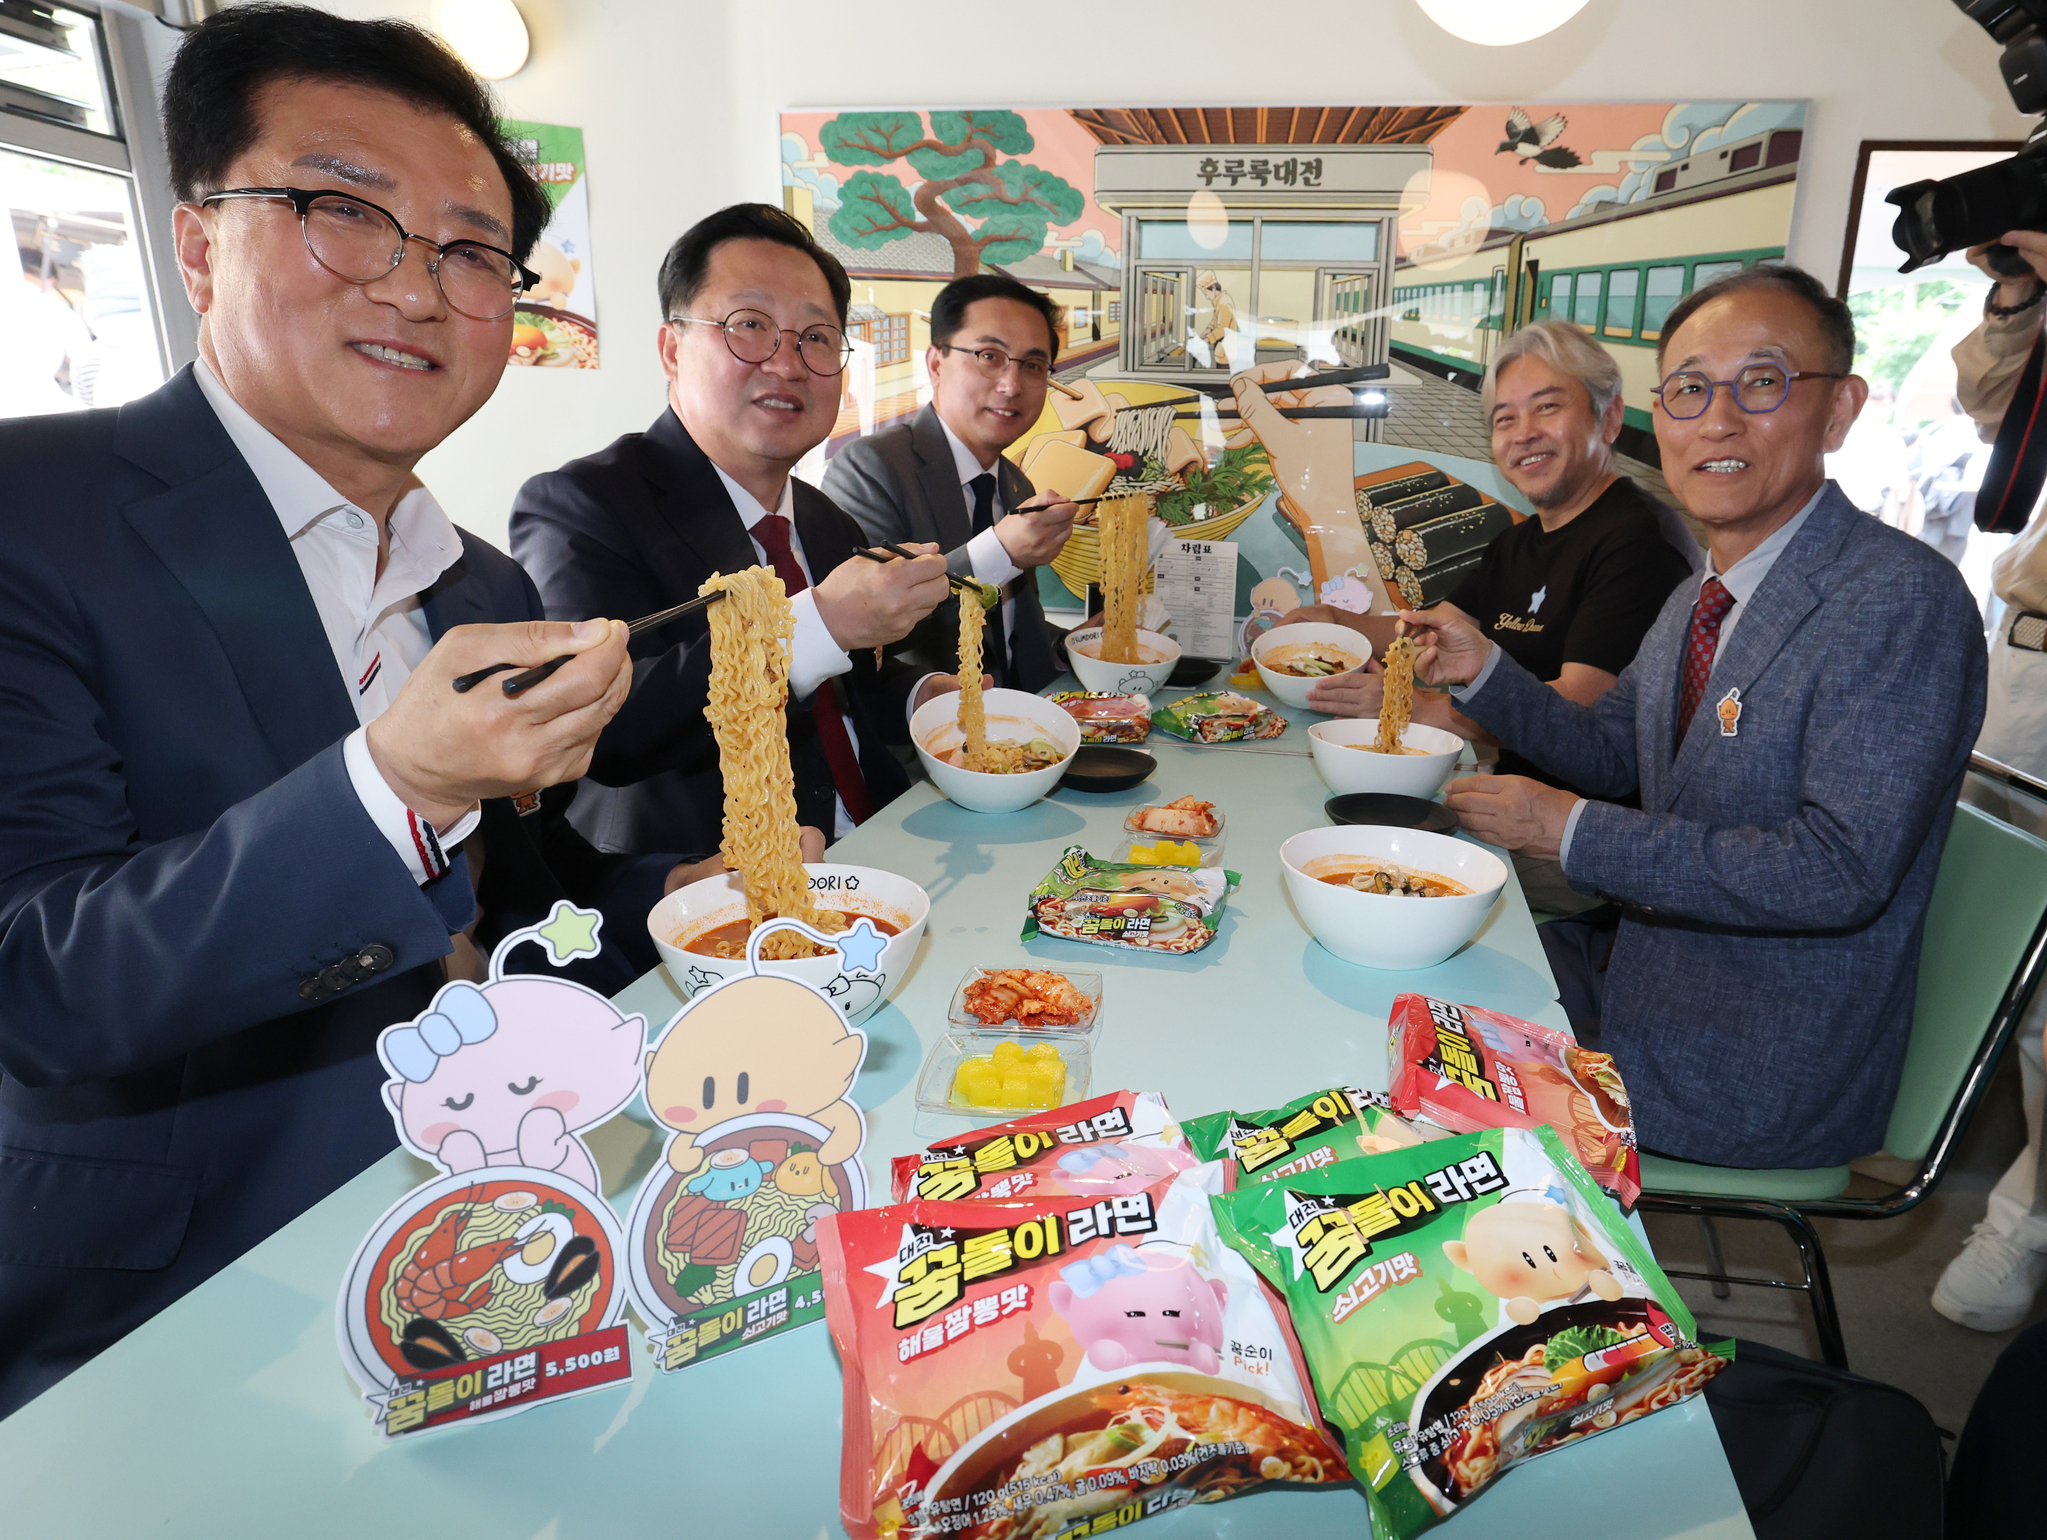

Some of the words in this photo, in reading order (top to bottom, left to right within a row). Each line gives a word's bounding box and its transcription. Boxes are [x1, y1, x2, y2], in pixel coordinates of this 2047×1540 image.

[1196, 156, 1323, 187] 후루룩대전
[1181, 542, 1213, 555] 차림표
[1082, 918, 1126, 935] 꿈돌이
[1126, 918, 1152, 930] 라면
[1232, 1090, 1352, 1174] 꿈돌이
[917, 1130, 1055, 1201] 꿈돌이
[1054, 1107, 1132, 1145] 라면
[1288, 1200, 1320, 1230] 대전
[1295, 1180, 1440, 1293] 꿈돌이
[1424, 1151, 1509, 1205] 라면
[893, 1214, 1064, 1329] 꿈돌이
[1066, 1192, 1156, 1247] 라면
[898, 1232, 934, 1264] 대전
[1331, 1250, 1421, 1323] 쇠고기맛
[664, 1306, 744, 1371] 꿈돌이
[746, 1286, 789, 1324] 라면
[794, 1288, 826, 1310] 4,5
[741, 1310, 789, 1342] 쇠고기맛
[898, 1283, 1032, 1363] 해물짬뽕맛
[1230, 1339, 1273, 1361] 꿈순이
[1233, 1355, 1270, 1377] Pick!
[385, 1369, 483, 1436] 꿈돌이
[486, 1351, 539, 1390] 라면
[544, 1345, 622, 1378] 5,500원
[468, 1376, 538, 1413] 해물짬뽕맛
[1428, 1441, 1441, 1457] 중
[972, 1489, 996, 1507] 120
[1033, 1469, 1063, 1487] kcal)
[1034, 1483, 1075, 1507] 0.47%,
[1075, 1477, 1087, 1496] 굴
[1086, 1469, 1130, 1493] 0.09%,
[1127, 1460, 1160, 1481] 바지락
